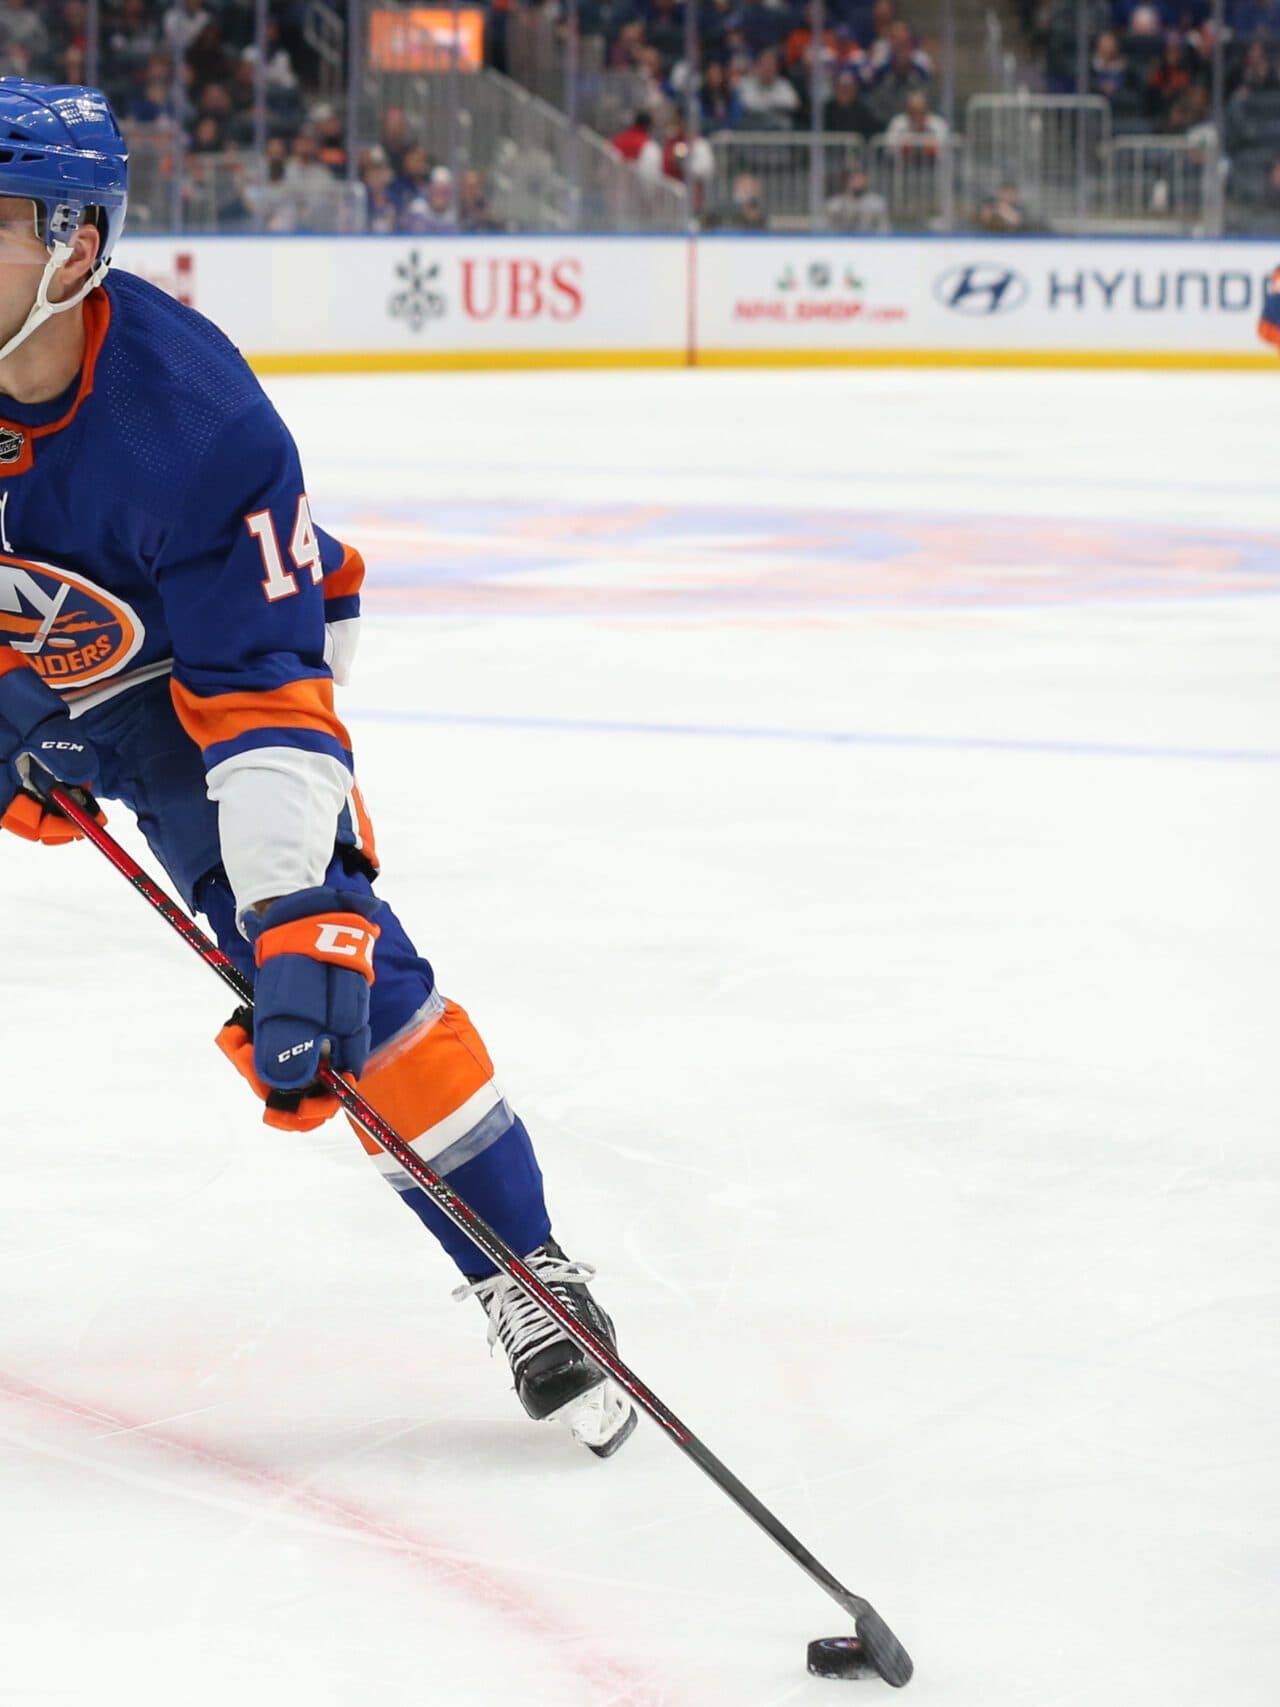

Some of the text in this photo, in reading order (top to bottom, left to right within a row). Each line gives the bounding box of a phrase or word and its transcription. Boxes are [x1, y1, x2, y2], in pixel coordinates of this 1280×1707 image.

[461, 259, 583, 321] UBS
[1048, 269, 1273, 311] HYUND
[244, 493, 323, 602] 14
[41, 740, 84, 753] CCM
